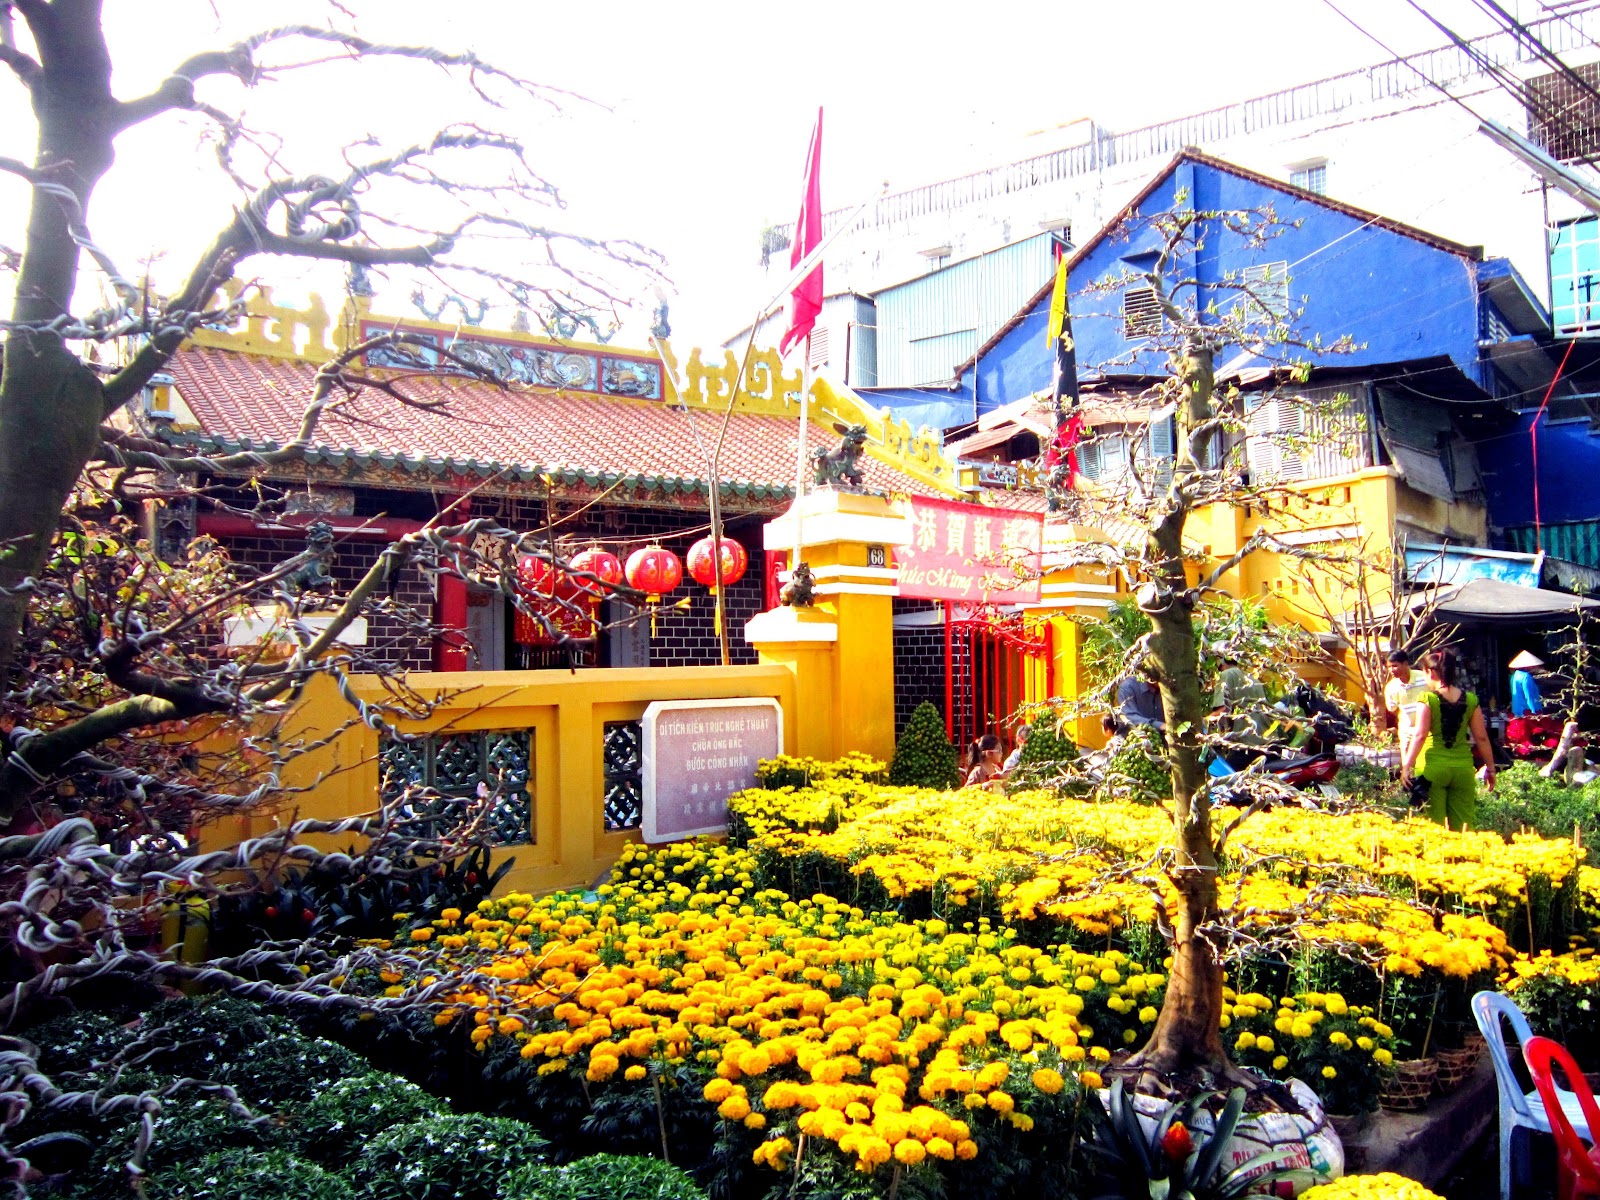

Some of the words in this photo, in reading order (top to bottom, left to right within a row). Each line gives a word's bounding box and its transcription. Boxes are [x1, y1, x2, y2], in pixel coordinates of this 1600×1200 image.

[871, 548, 884, 564] 68
[926, 567, 973, 597] Mừng
[669, 719, 686, 735] TÍCH
[705, 718, 724, 733] TRÚC
[725, 717, 745, 734] NGHỆ
[746, 715, 769, 732] THUẬT
[713, 737, 727, 750] ÔNG
[728, 734, 743, 749] BẮC
[707, 755, 727, 769] CÔNG
